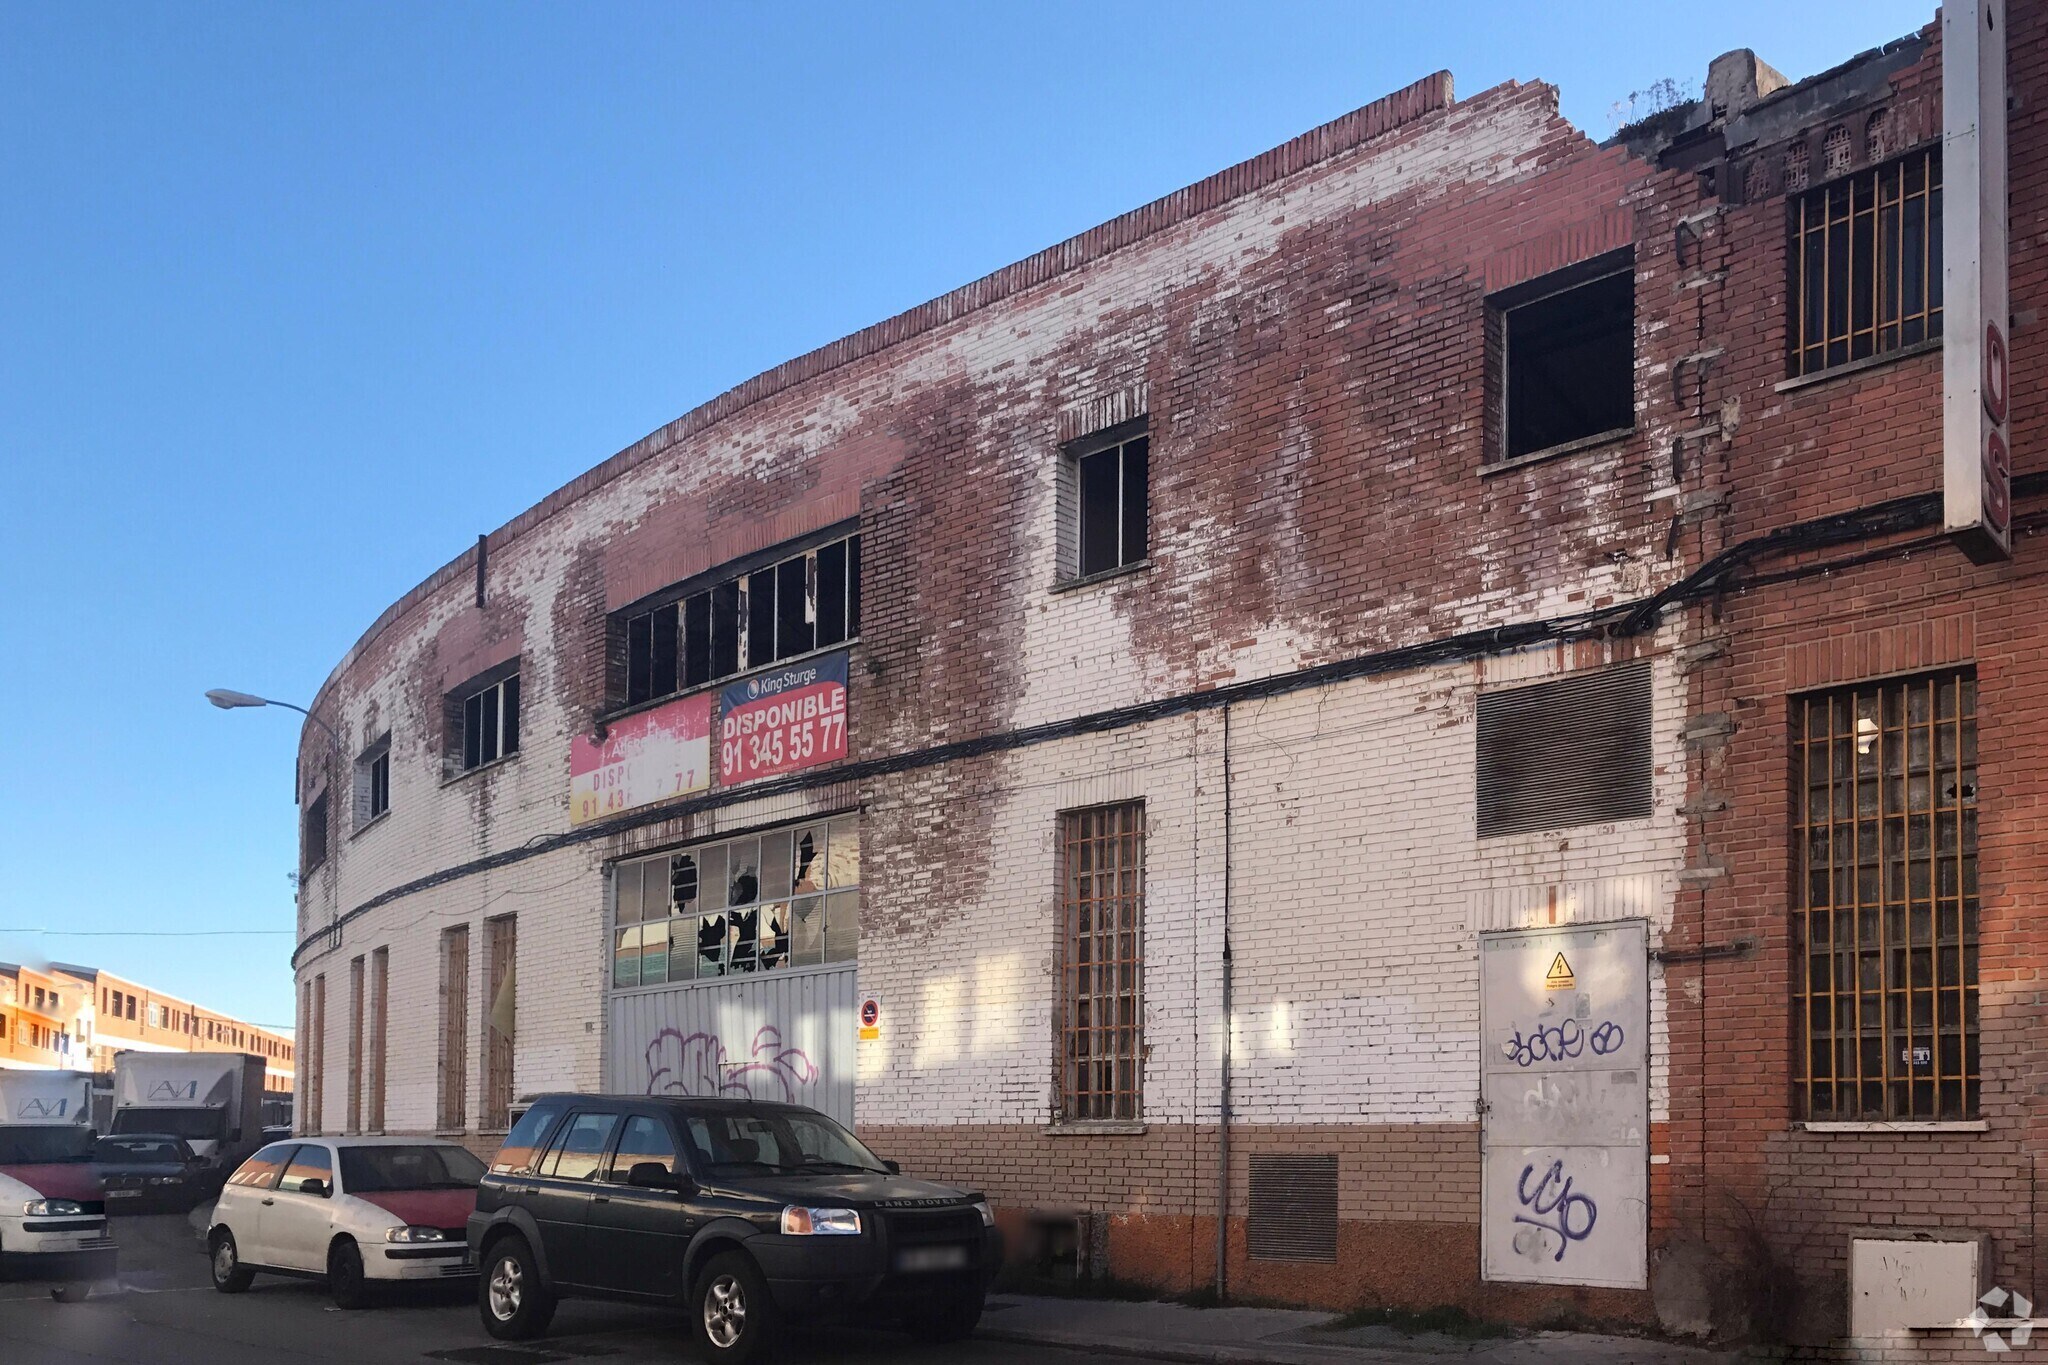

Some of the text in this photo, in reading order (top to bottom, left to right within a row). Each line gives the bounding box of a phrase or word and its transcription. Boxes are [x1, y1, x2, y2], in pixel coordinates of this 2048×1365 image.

[761, 668, 817, 694] King Sturge
[723, 686, 845, 739] DISPONIBLE
[723, 712, 845, 776] 91 345 55 77
[582, 797, 598, 818] 91
[674, 769, 695, 791] 77
[917, 1198, 958, 1206] ROVER
